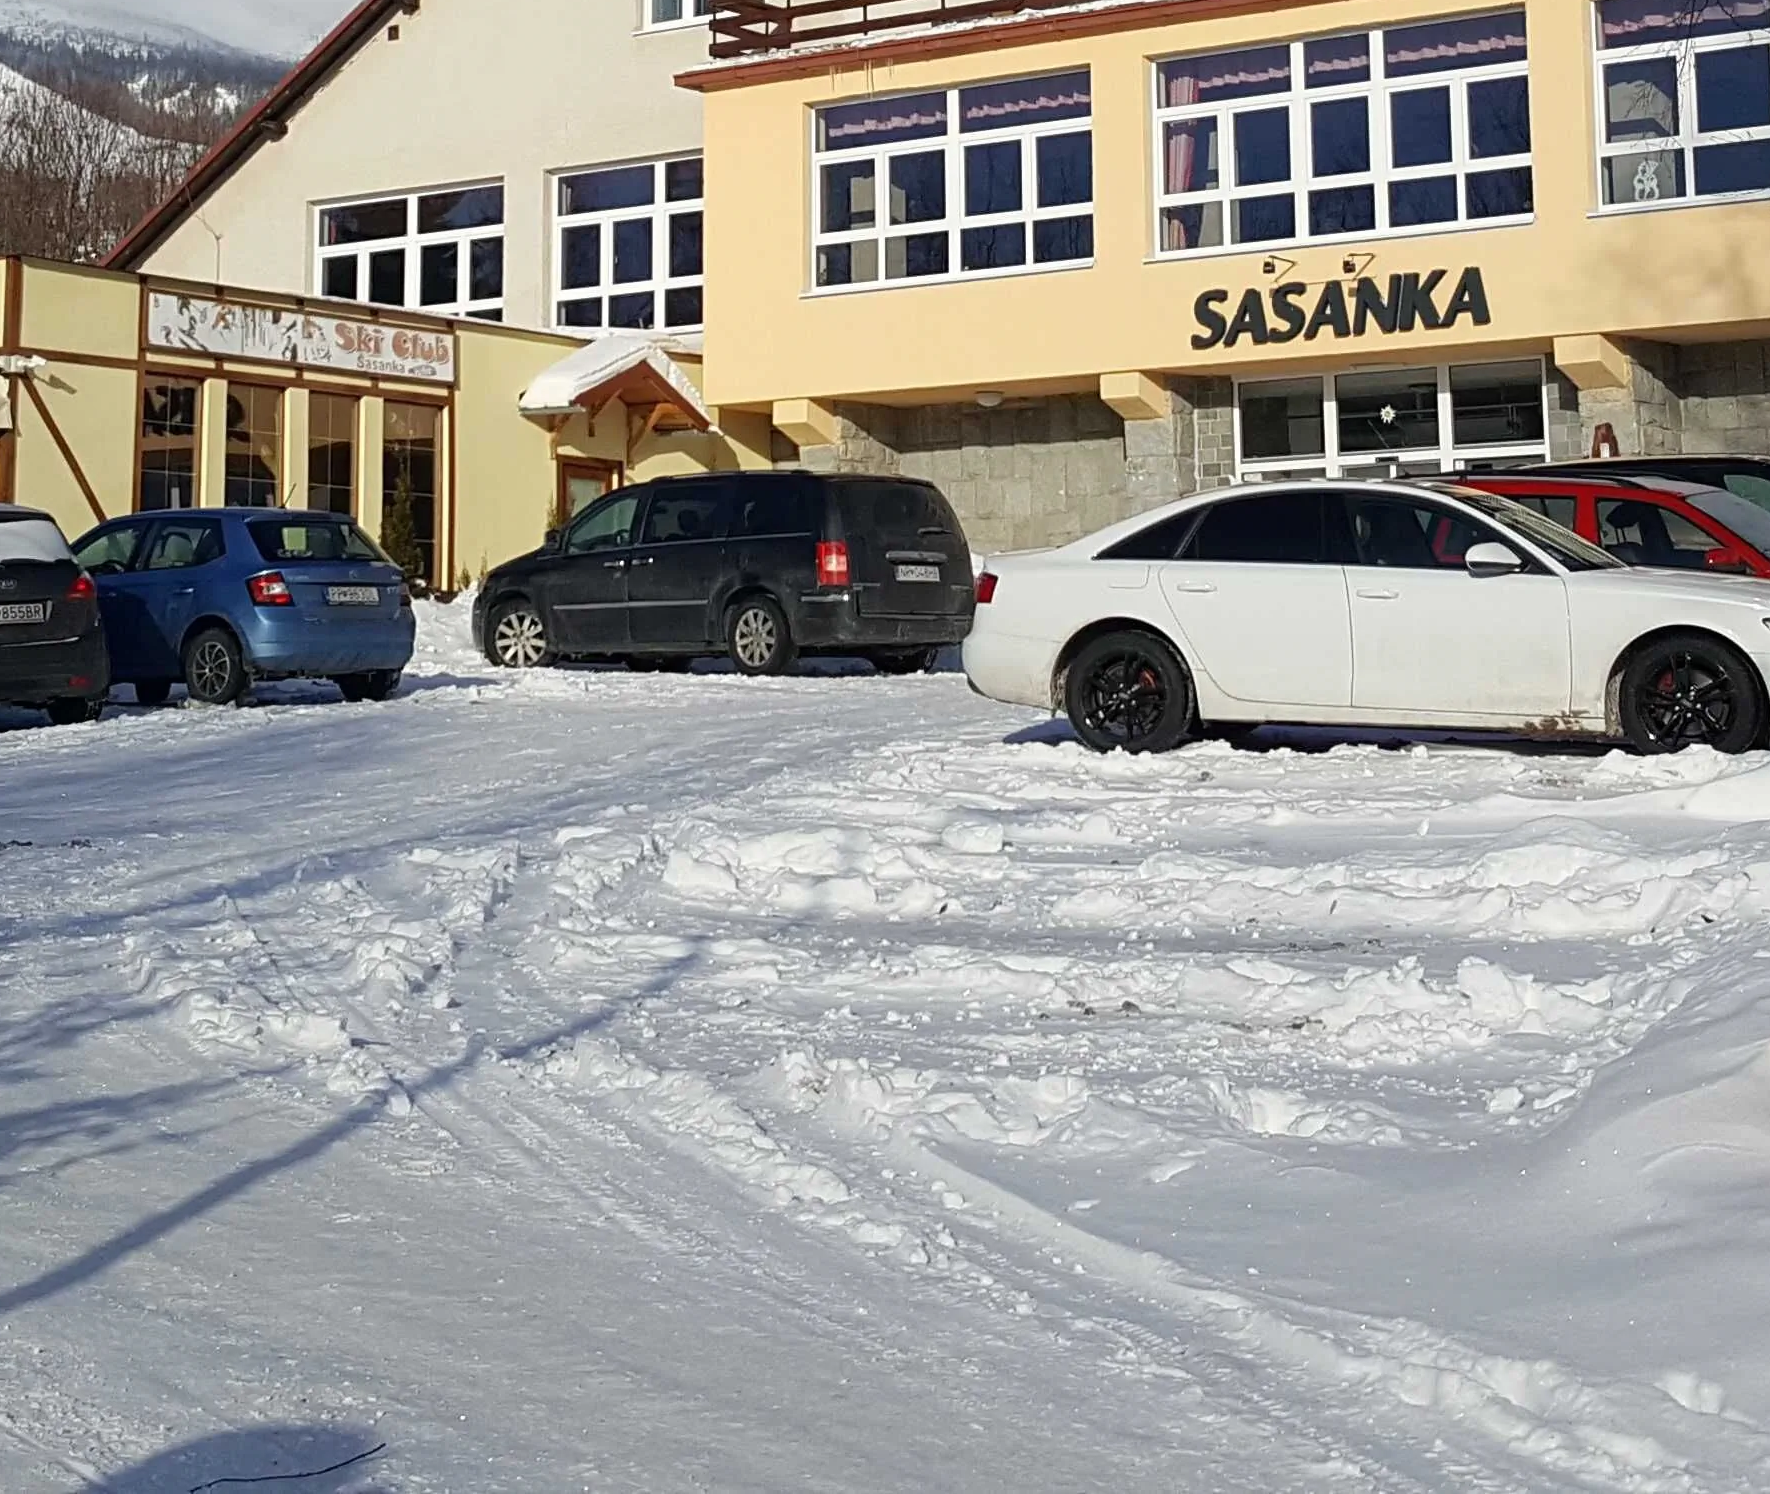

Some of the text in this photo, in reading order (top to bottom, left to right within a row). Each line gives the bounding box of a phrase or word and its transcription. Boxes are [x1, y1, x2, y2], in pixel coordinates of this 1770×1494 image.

[1191, 266, 1491, 350] SASANKA
[335, 322, 450, 365] Ski Club
